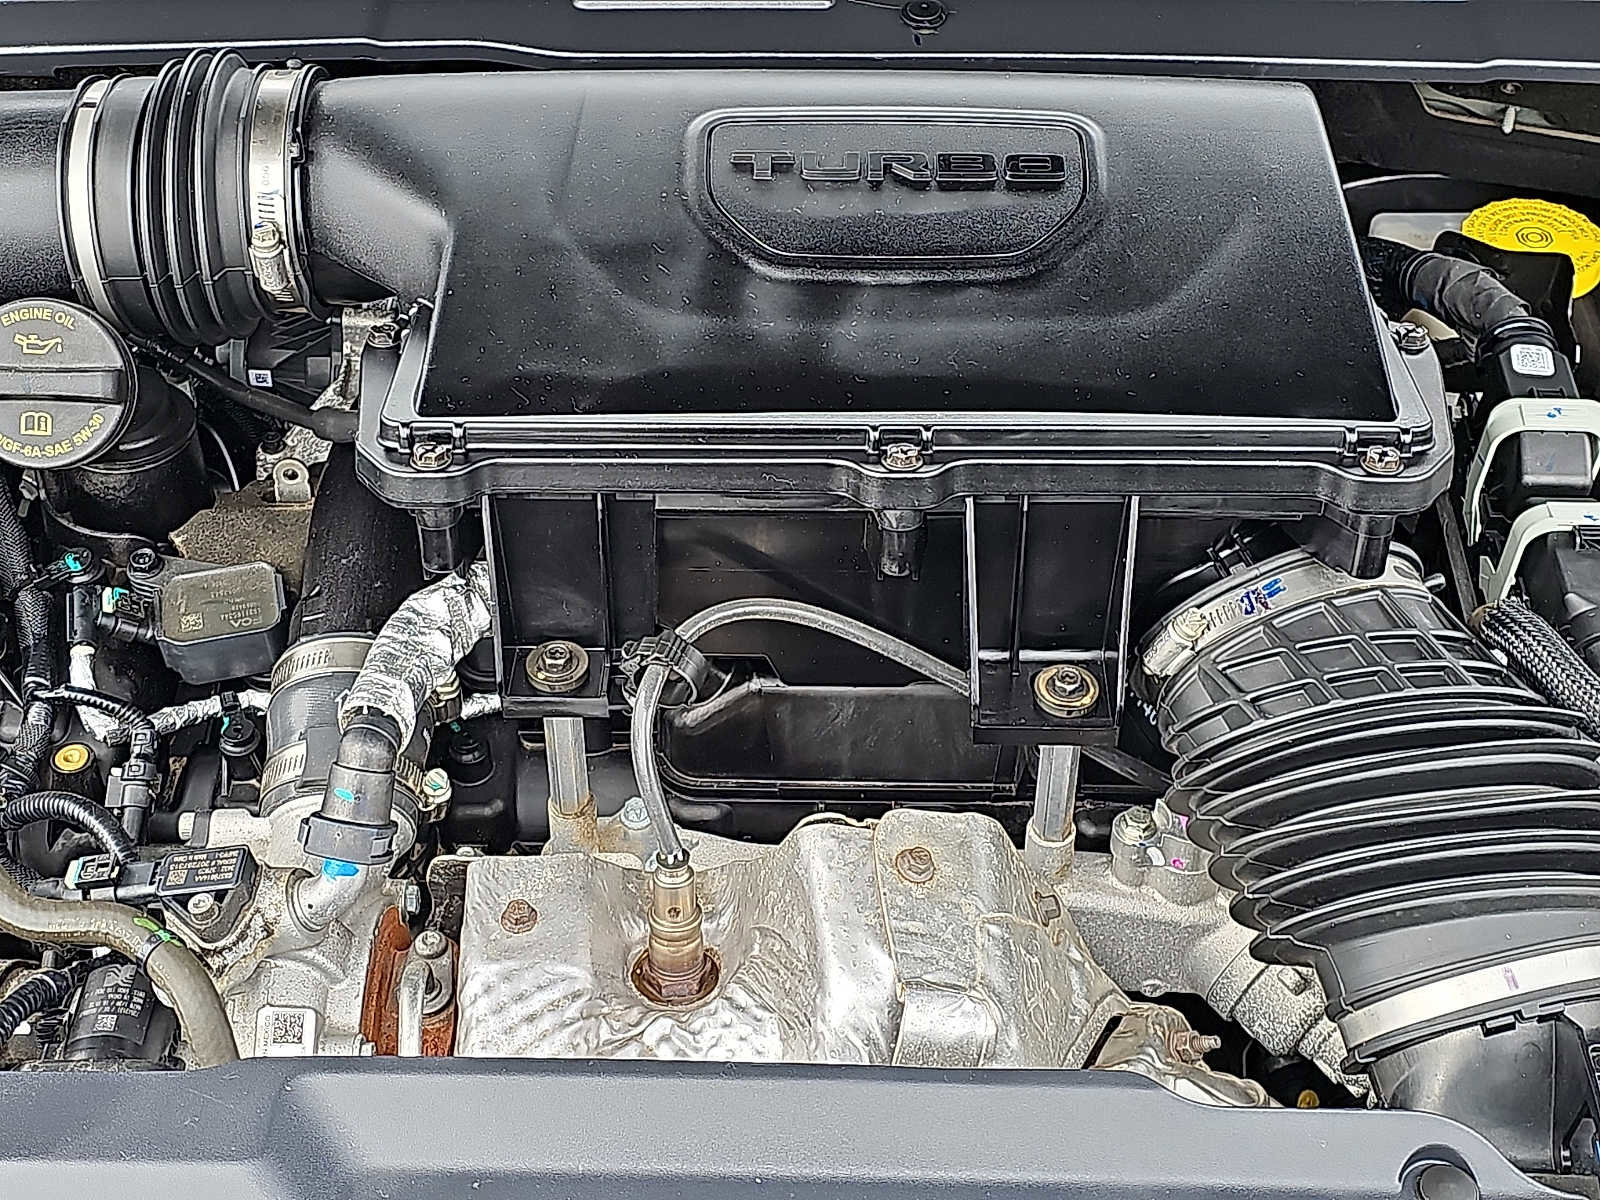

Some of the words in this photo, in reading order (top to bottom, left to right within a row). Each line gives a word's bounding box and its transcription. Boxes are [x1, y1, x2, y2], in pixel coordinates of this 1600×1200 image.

[729, 150, 1066, 189] TURBO
[0, 308, 53, 326] ENGINE
[55, 313, 76, 330] OIL
[72, 414, 104, 445] 5W-30
